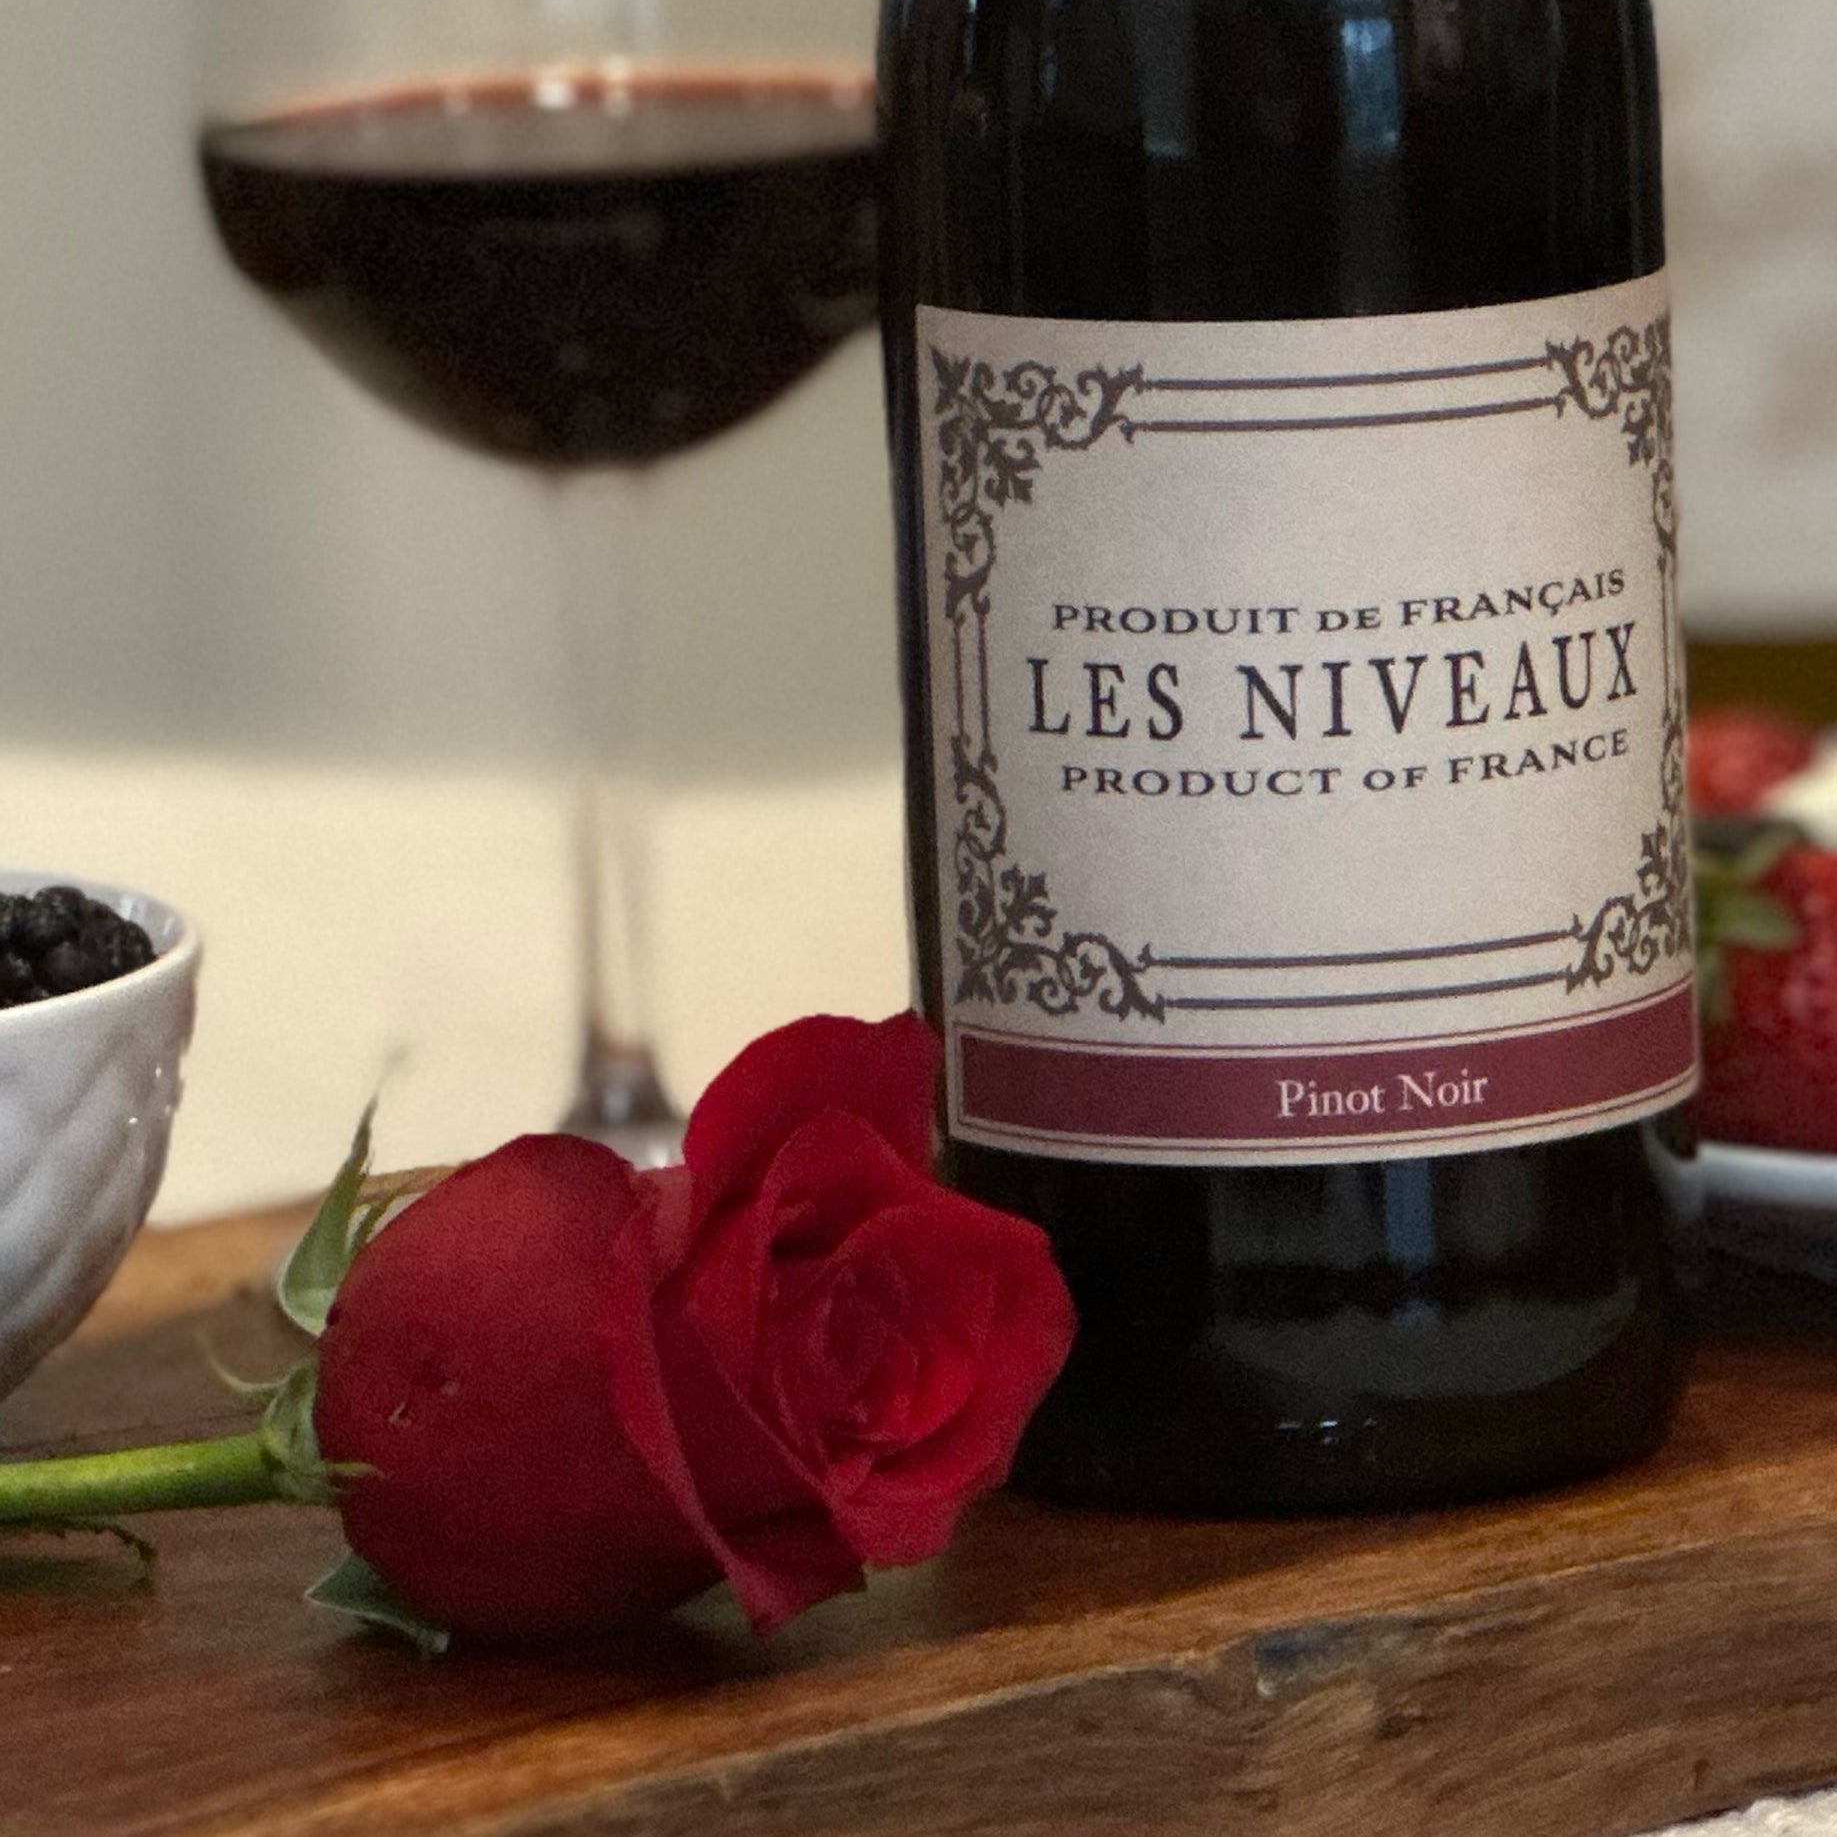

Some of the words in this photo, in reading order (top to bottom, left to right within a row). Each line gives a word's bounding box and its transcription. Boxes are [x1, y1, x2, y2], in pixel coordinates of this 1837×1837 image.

[1052, 604, 1300, 635] PRODUIT
[1317, 606, 1382, 633] DE
[1401, 568, 1626, 627] FRANÇAIS
[1026, 658, 1184, 741] LES
[1236, 621, 1638, 741] NIVEAUX
[1062, 764, 1341, 797] PRODUCT
[1362, 764, 1428, 792] OF
[1447, 728, 1629, 785] FRANCE
[1275, 1079, 1386, 1119] Pinot
[1397, 1067, 1489, 1112] Noir
